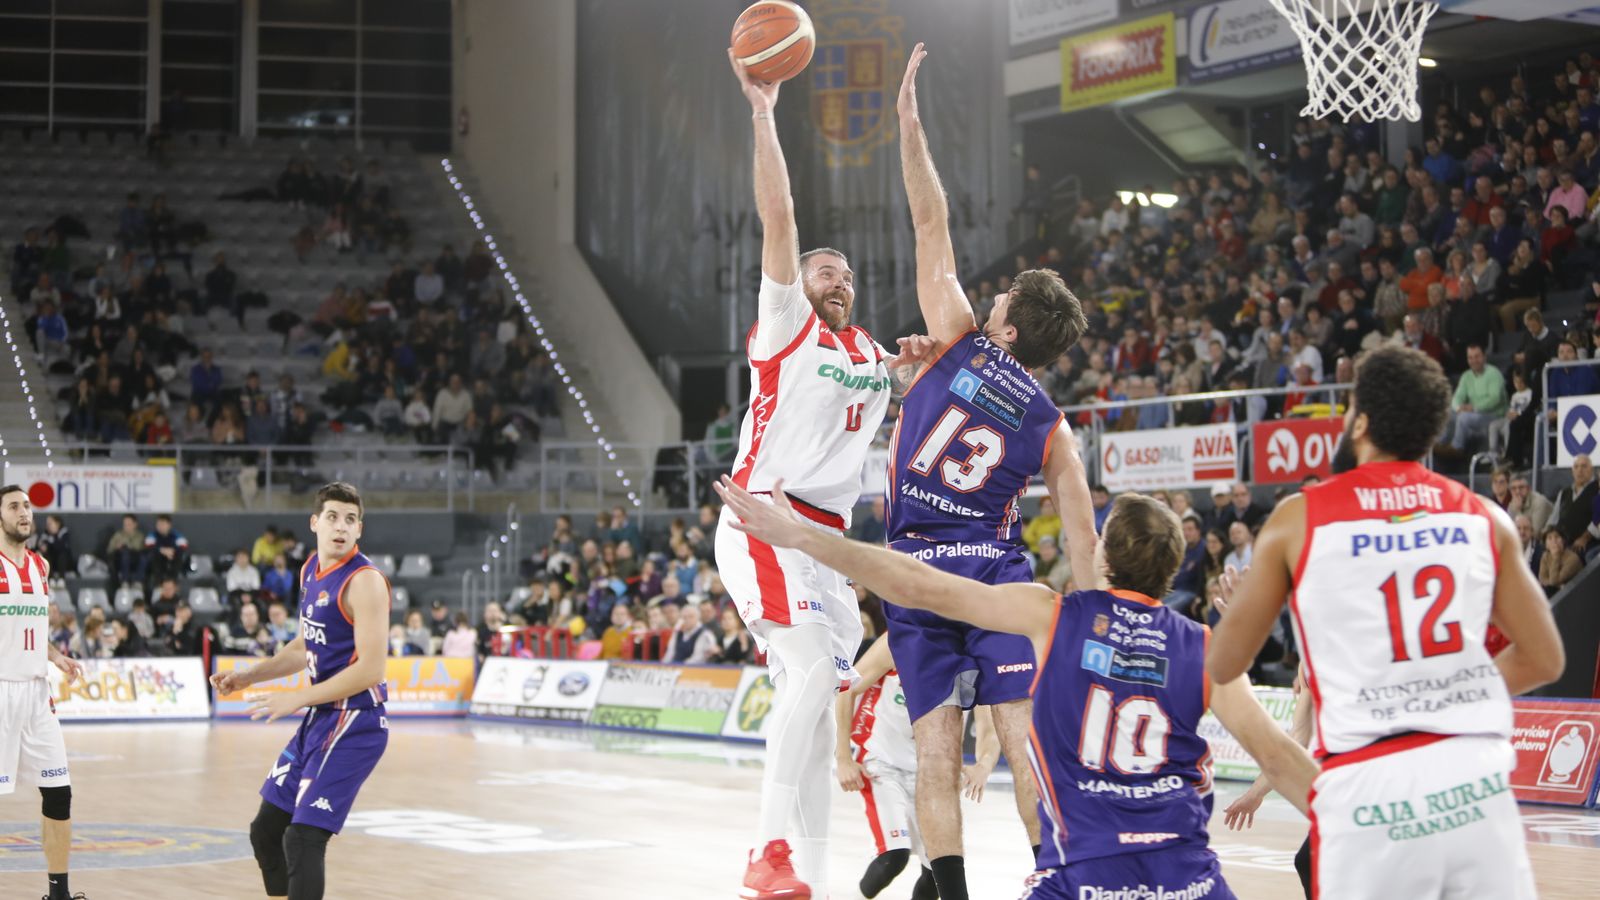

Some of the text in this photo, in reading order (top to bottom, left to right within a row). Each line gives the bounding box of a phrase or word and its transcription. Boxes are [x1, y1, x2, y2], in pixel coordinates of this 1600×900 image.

[982, 368, 1032, 404] de Palencia
[988, 360, 1037, 396] Ayuntamiento
[975, 394, 1020, 429] DE PALENCIA
[979, 386, 1016, 415] Diputación
[908, 404, 1006, 494] 13
[1303, 433, 1343, 469] OV
[1354, 483, 1443, 511] WRIGHT
[1351, 527, 1470, 557] PULEVA
[0, 604, 49, 617] COVIRA
[1378, 564, 1465, 664] 12
[24, 627, 35, 651] 11
[997, 661, 1034, 675] Kappa
[1356, 663, 1500, 705] AYUNTAMIENTO
[1079, 683, 1171, 775] 10
[1369, 706, 1396, 721] DE
[1077, 775, 1184, 799] MANTENEO
[1353, 771, 1509, 827] CAJA RURAL
[1388, 805, 1486, 843] GRANADA
